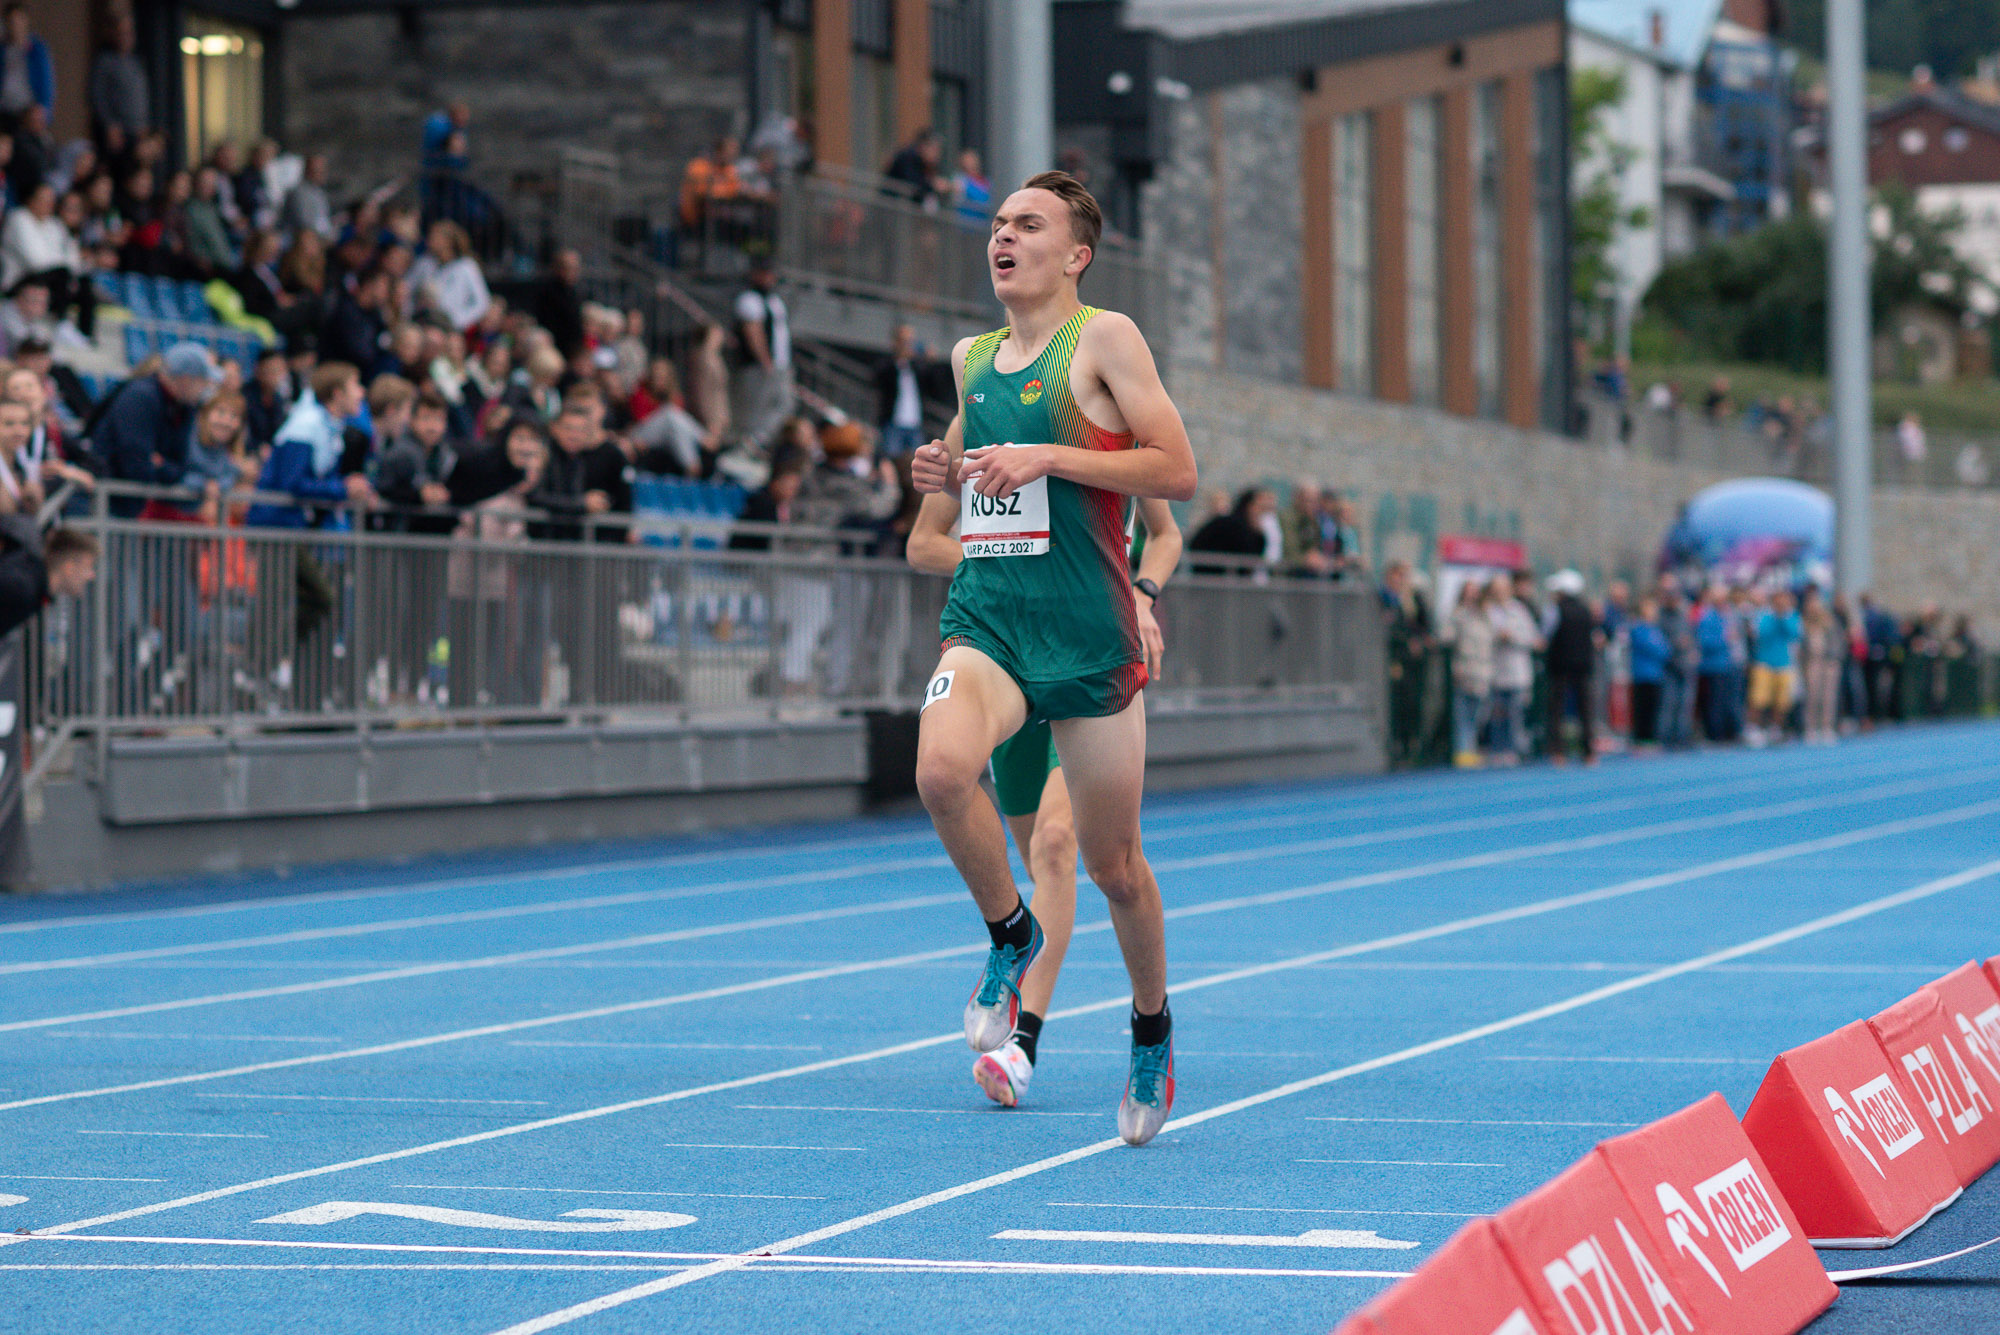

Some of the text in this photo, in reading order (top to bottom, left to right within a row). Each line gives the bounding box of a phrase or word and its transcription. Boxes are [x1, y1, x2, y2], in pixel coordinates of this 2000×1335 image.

[971, 491, 1022, 517] KUSZ
[1009, 542, 1034, 553] 2021
[1005, 907, 1024, 929] PUMA
[1860, 1084, 1916, 1148] ORLEN
[1901, 1033, 1993, 1144] PZLA
[252, 1201, 699, 1232] 2
[1708, 1173, 1781, 1255] ORLEN
